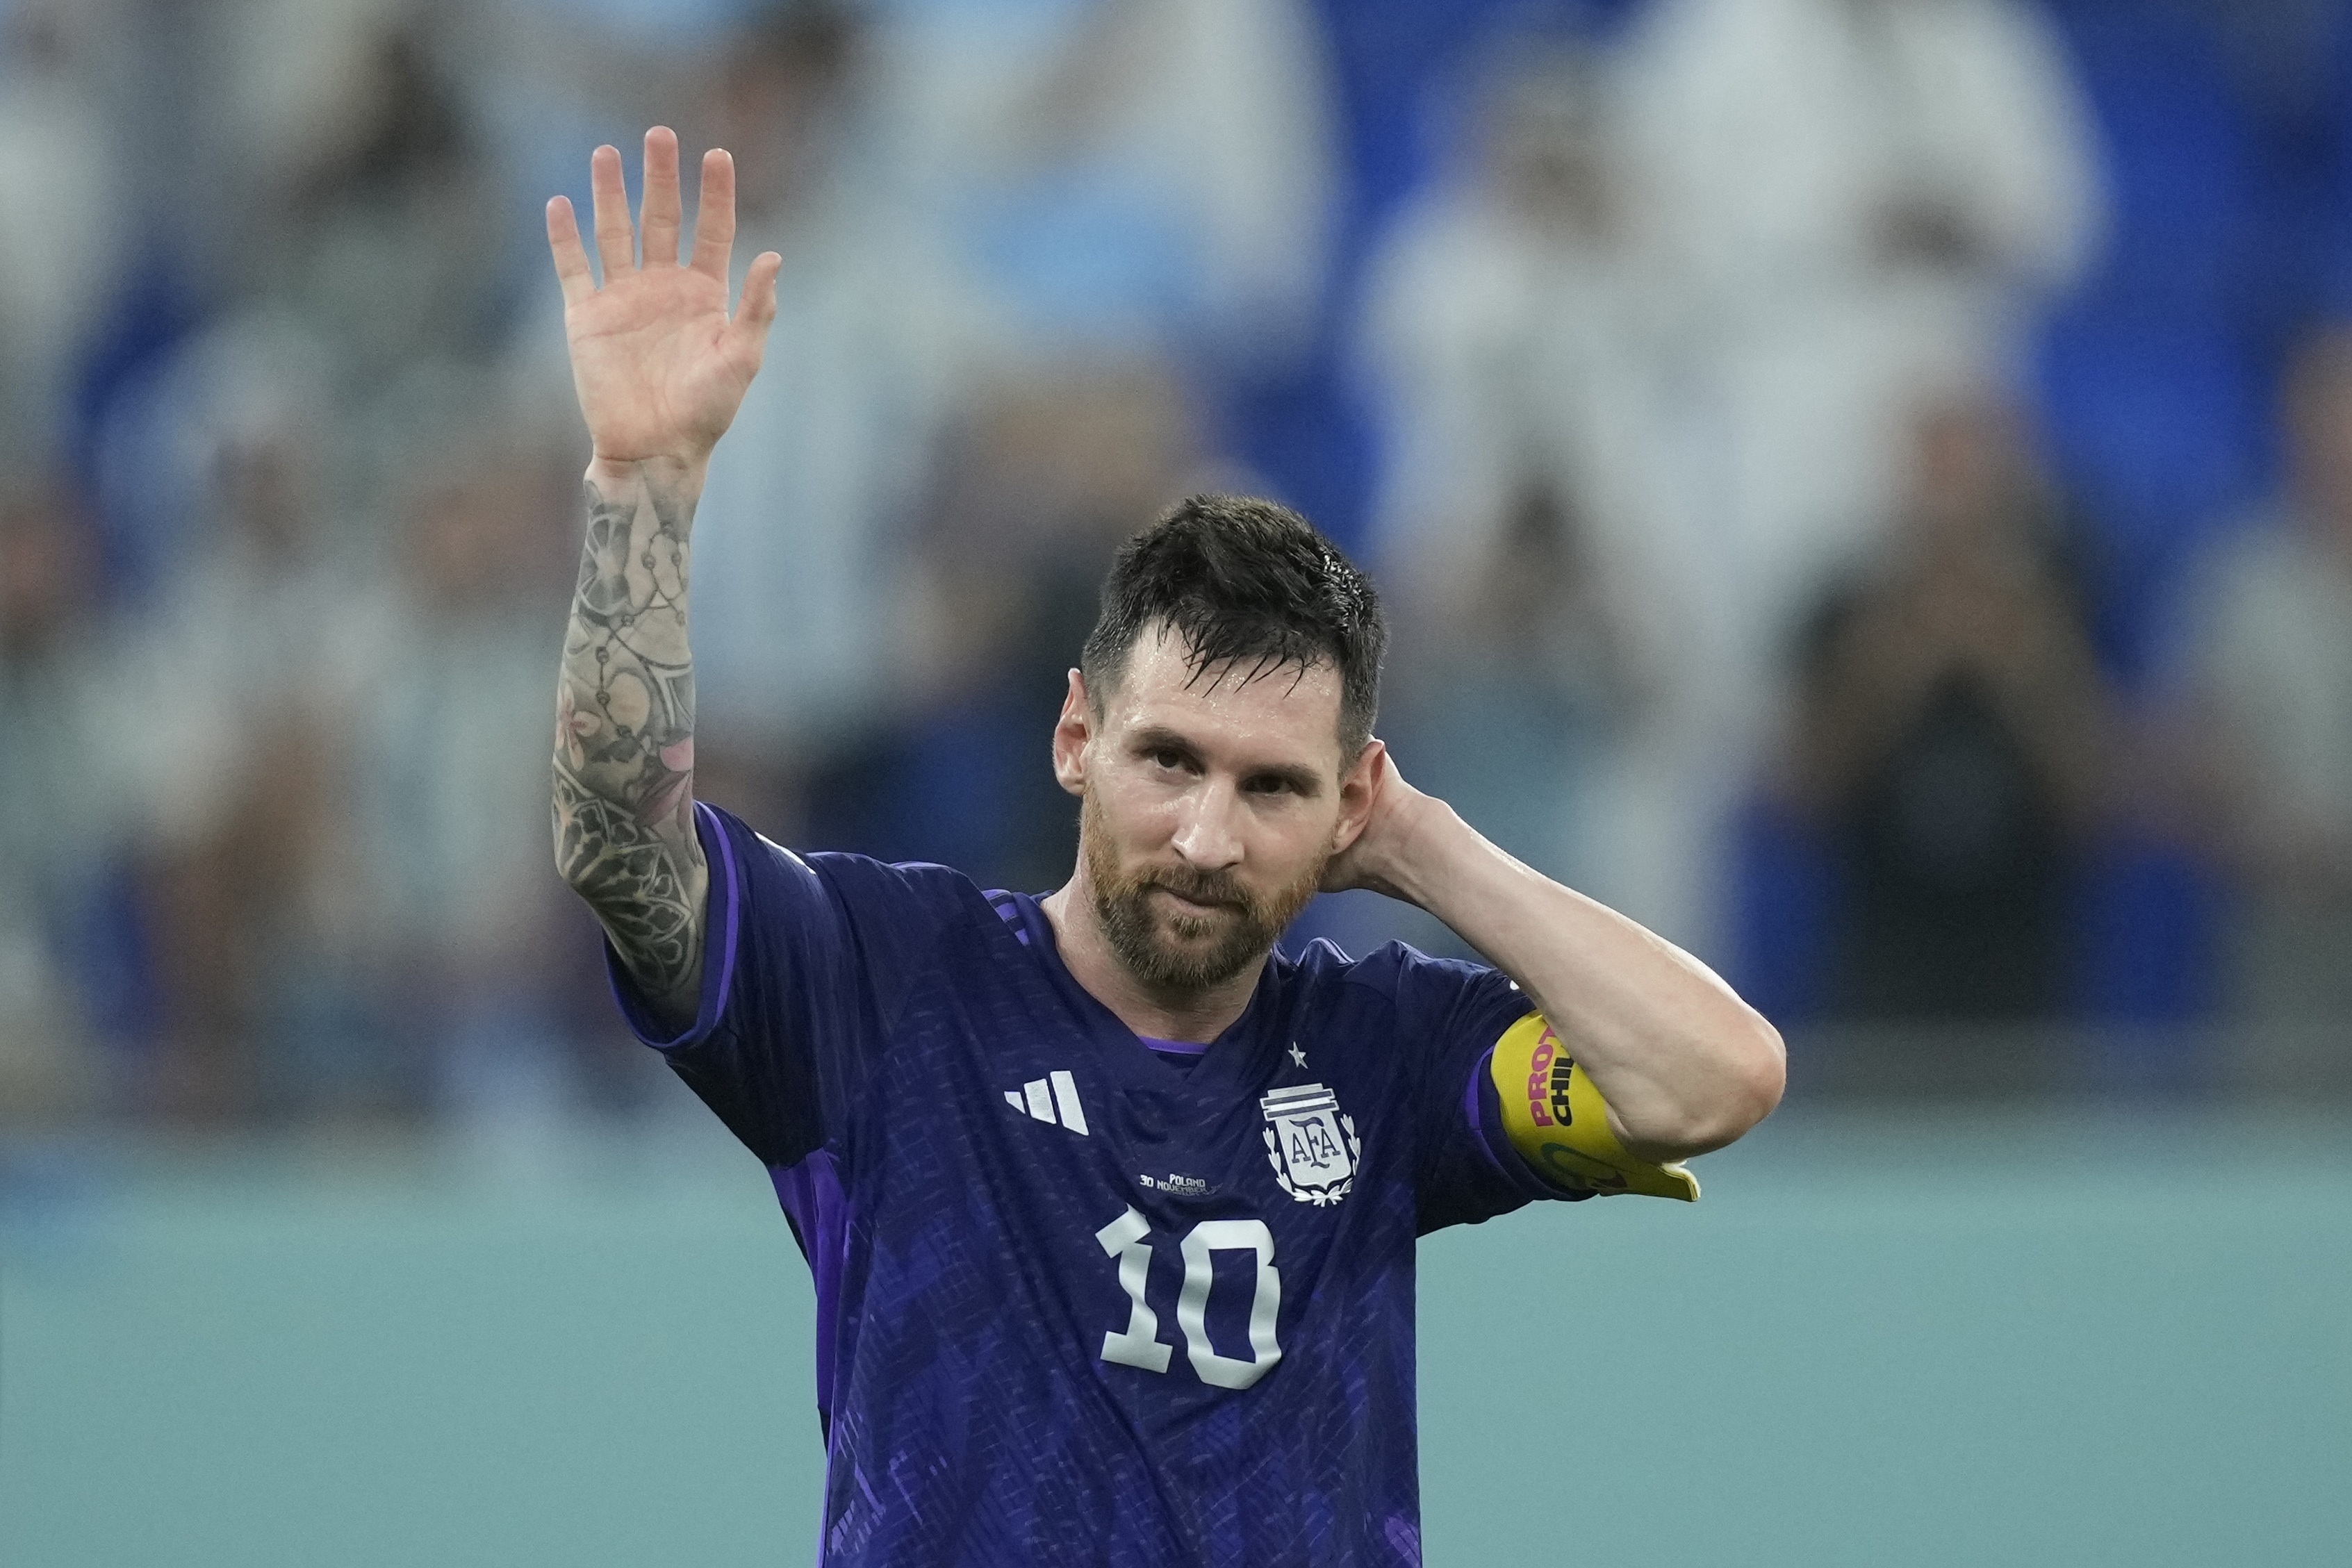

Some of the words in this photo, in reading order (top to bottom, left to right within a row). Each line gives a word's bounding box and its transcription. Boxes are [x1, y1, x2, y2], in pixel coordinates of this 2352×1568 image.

[1289, 1116, 1341, 1169] AFA
[1140, 1174, 1154, 1187] 30
[1169, 1173, 1206, 1187] POLAND
[1095, 1203, 1282, 1390] 10
